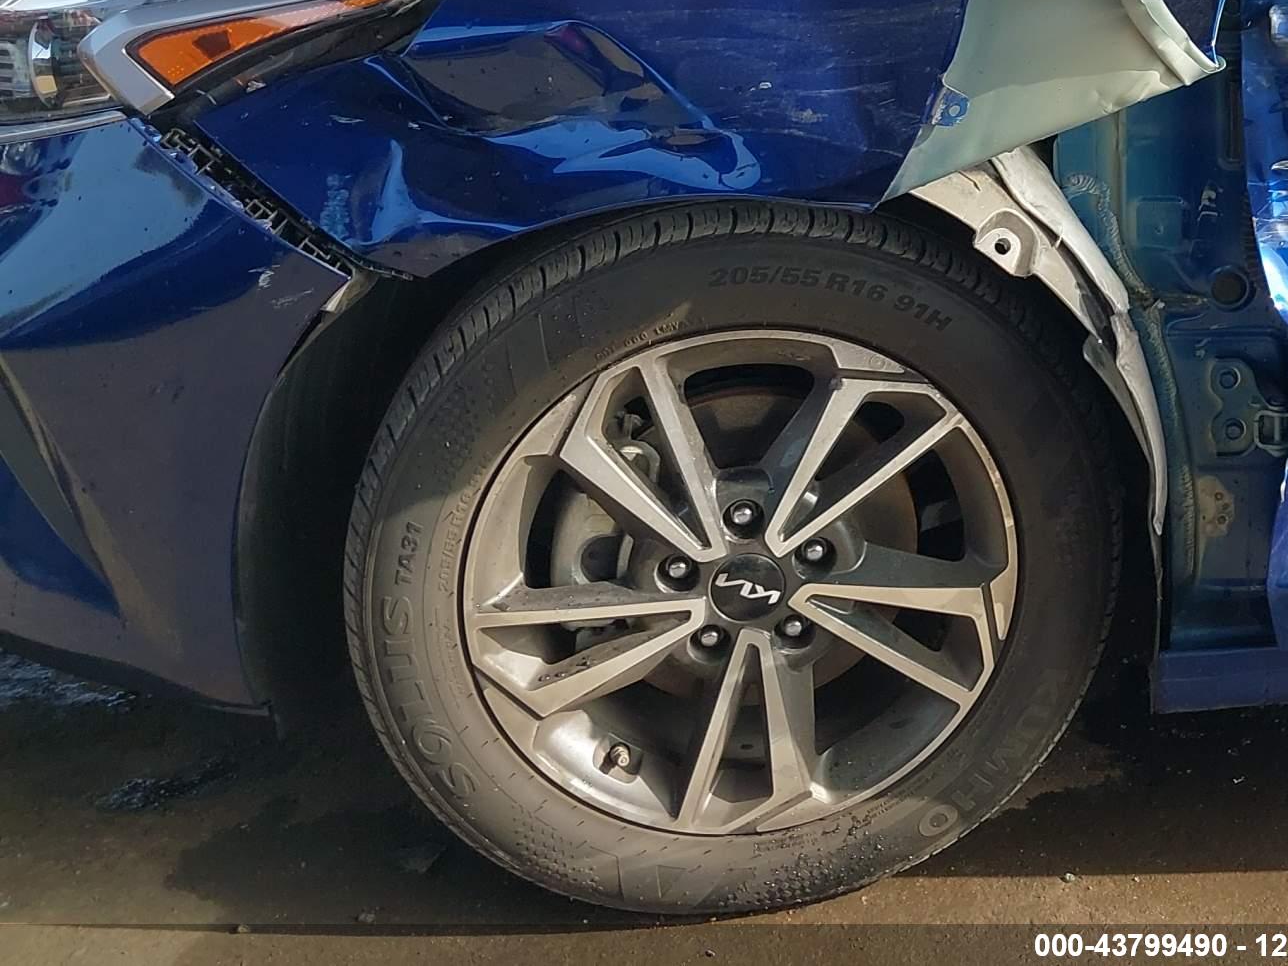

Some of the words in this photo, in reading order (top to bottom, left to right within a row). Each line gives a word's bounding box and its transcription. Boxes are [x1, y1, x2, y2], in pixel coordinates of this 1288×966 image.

[709, 265, 822, 288] 205/55
[824, 272, 889, 303] R16
[893, 294, 953, 332] 91H
[394, 520, 424, 587] TA31
[382, 595, 482, 800] SOLUS
[918, 665, 1072, 838] KUMHO
